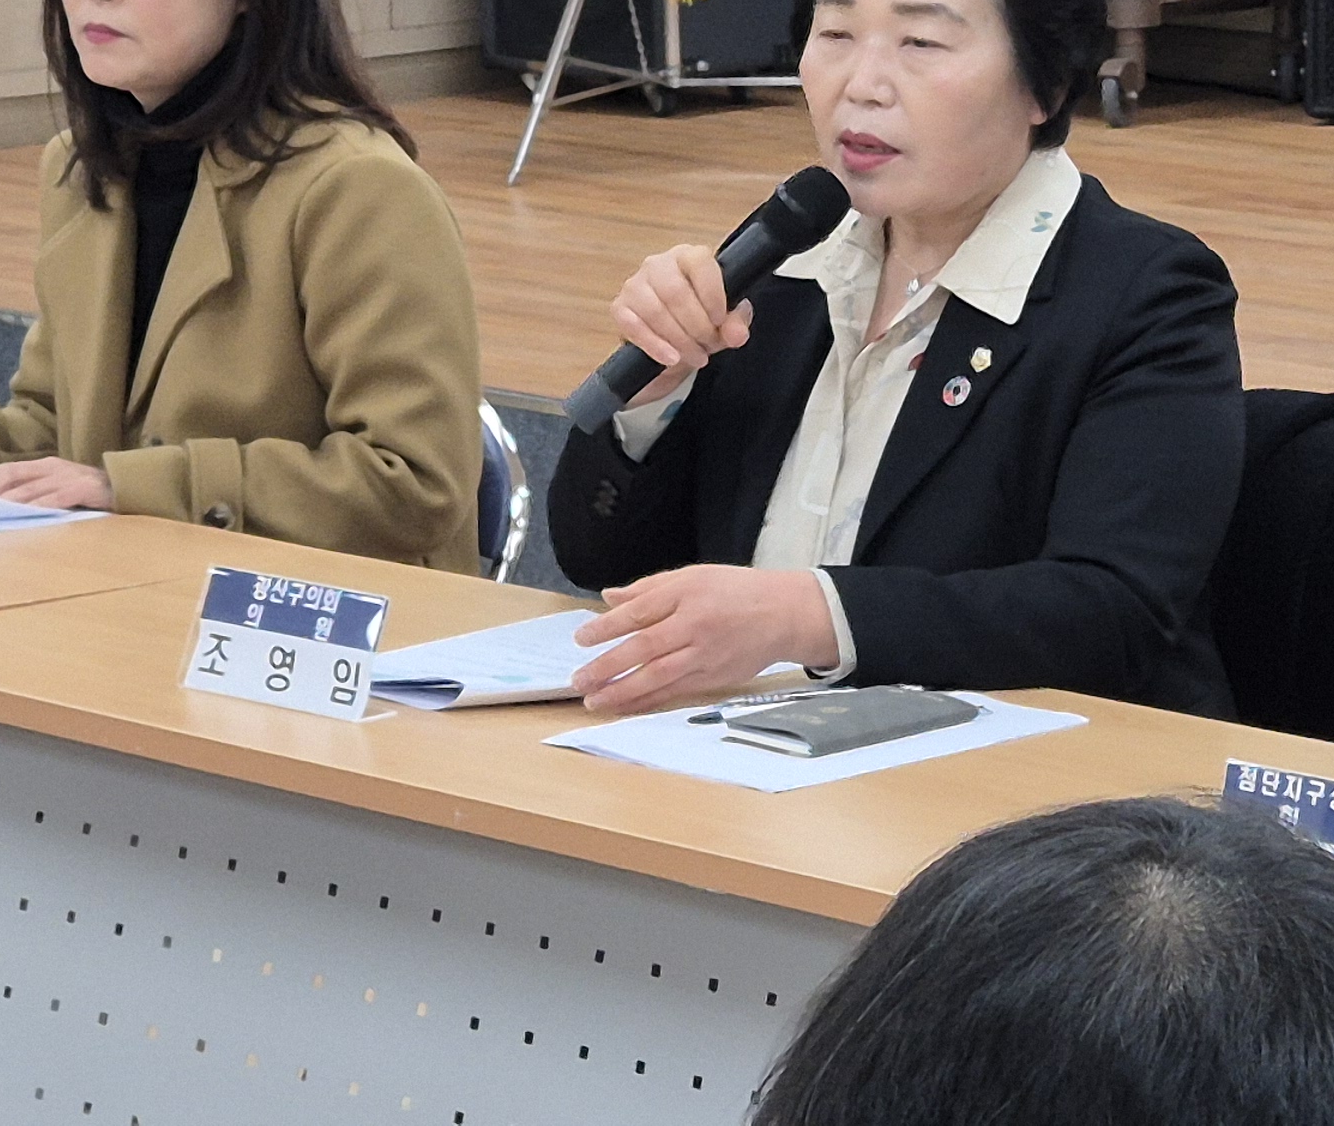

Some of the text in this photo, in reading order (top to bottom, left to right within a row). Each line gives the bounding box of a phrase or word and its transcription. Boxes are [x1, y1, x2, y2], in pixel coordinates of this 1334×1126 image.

[197, 632, 361, 707] 조 영 임
